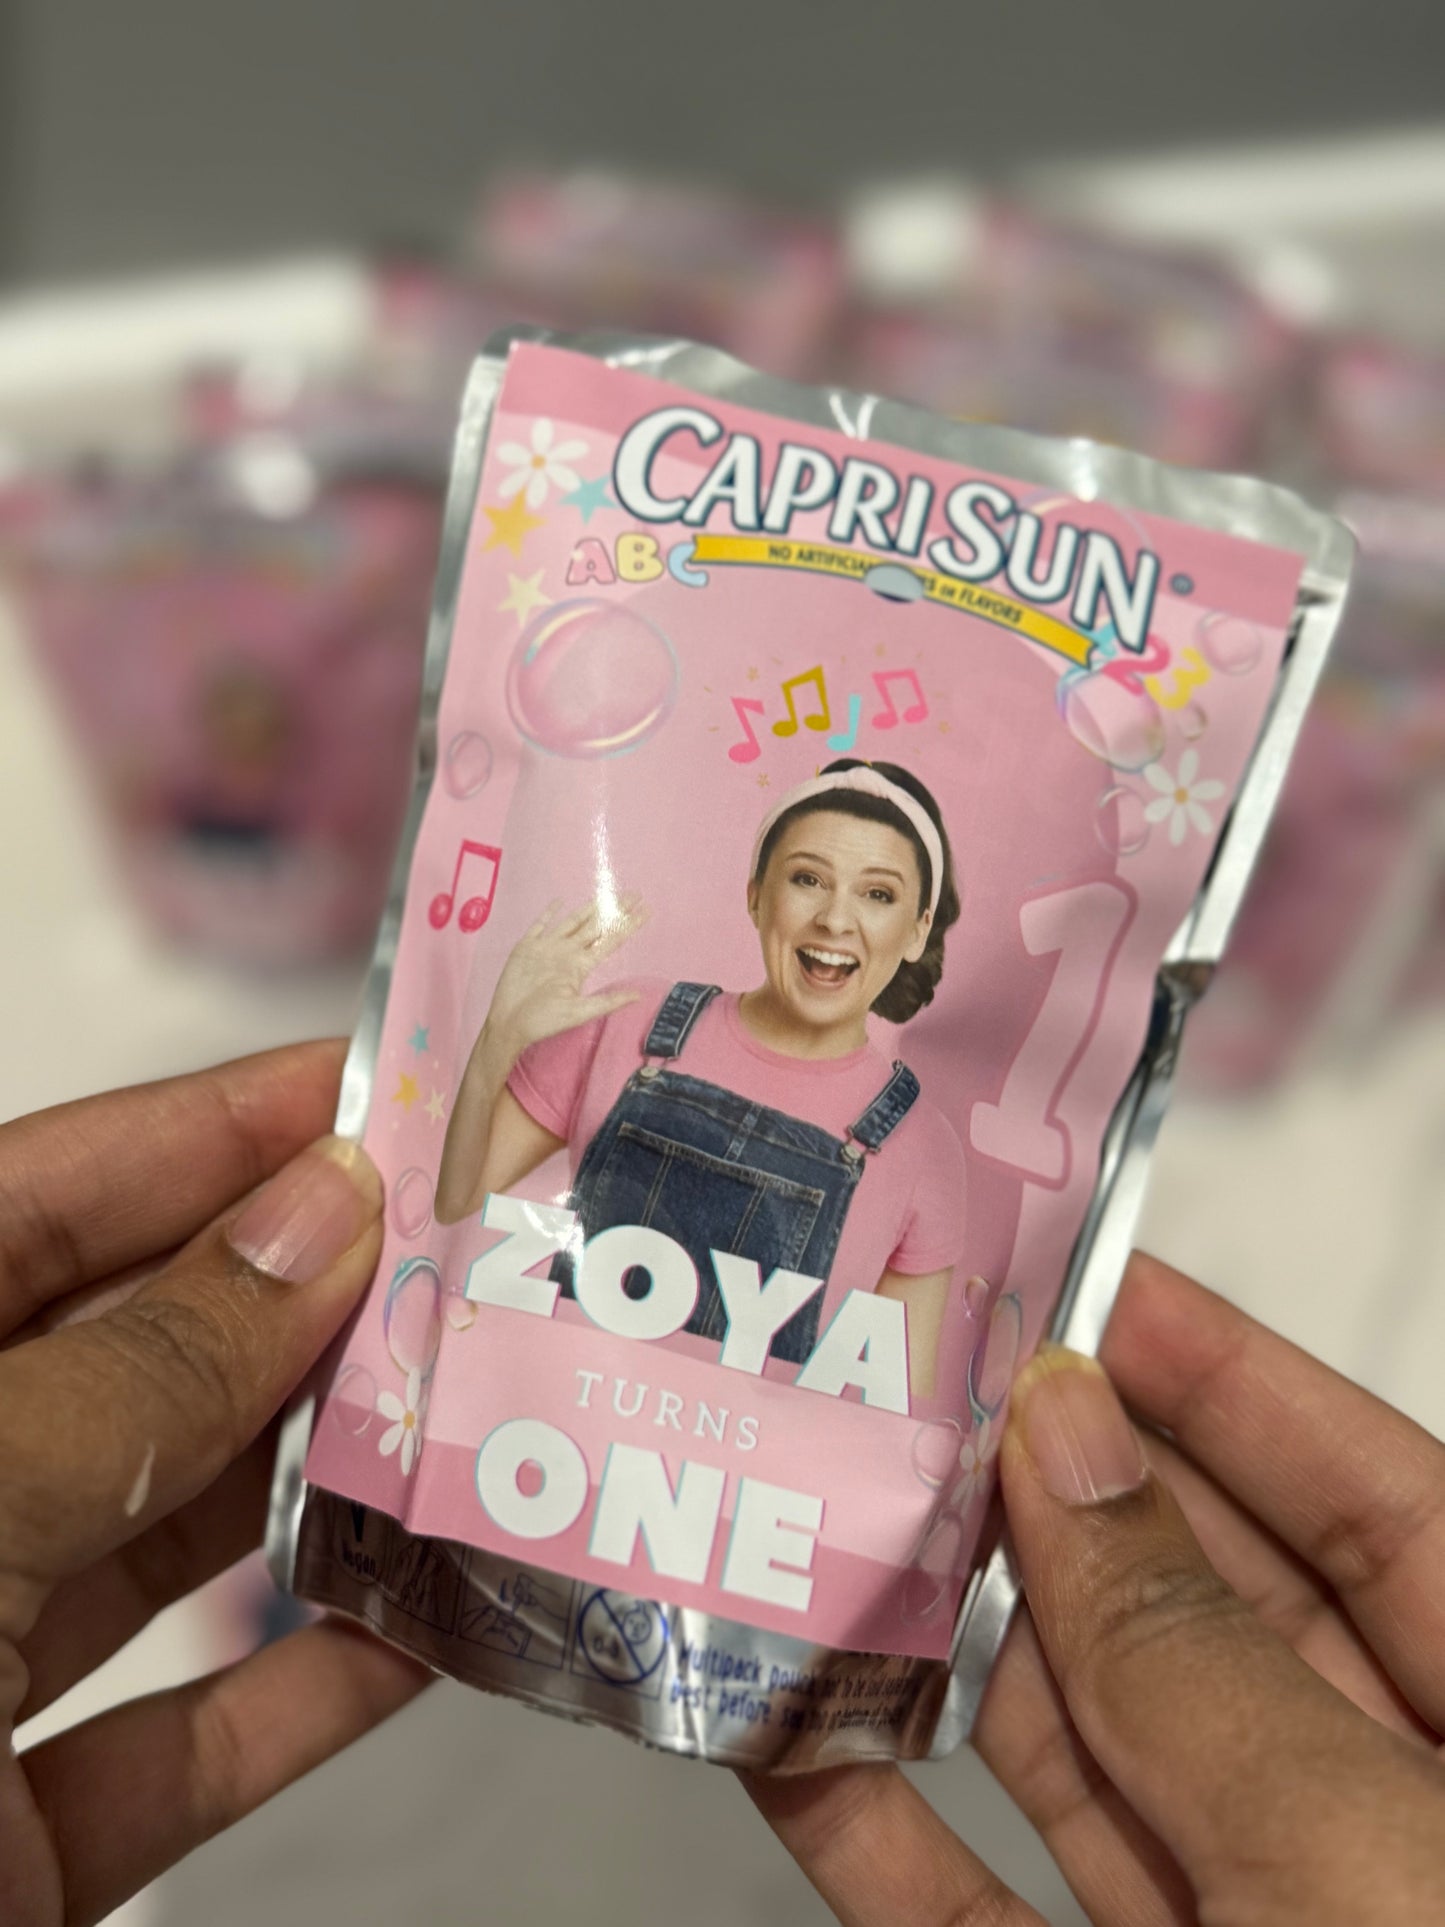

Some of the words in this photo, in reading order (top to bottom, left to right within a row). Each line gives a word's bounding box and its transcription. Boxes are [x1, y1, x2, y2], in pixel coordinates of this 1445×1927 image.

[565, 531, 709, 588] ABC
[768, 544, 792, 561] NO
[796, 547, 874, 573] ARTIFICIA
[959, 586, 1023, 625] FLAVORS
[463, 1191, 912, 1416] ZOYA
[574, 1368, 761, 1452] TURNS
[474, 1417, 826, 1613] ONE
